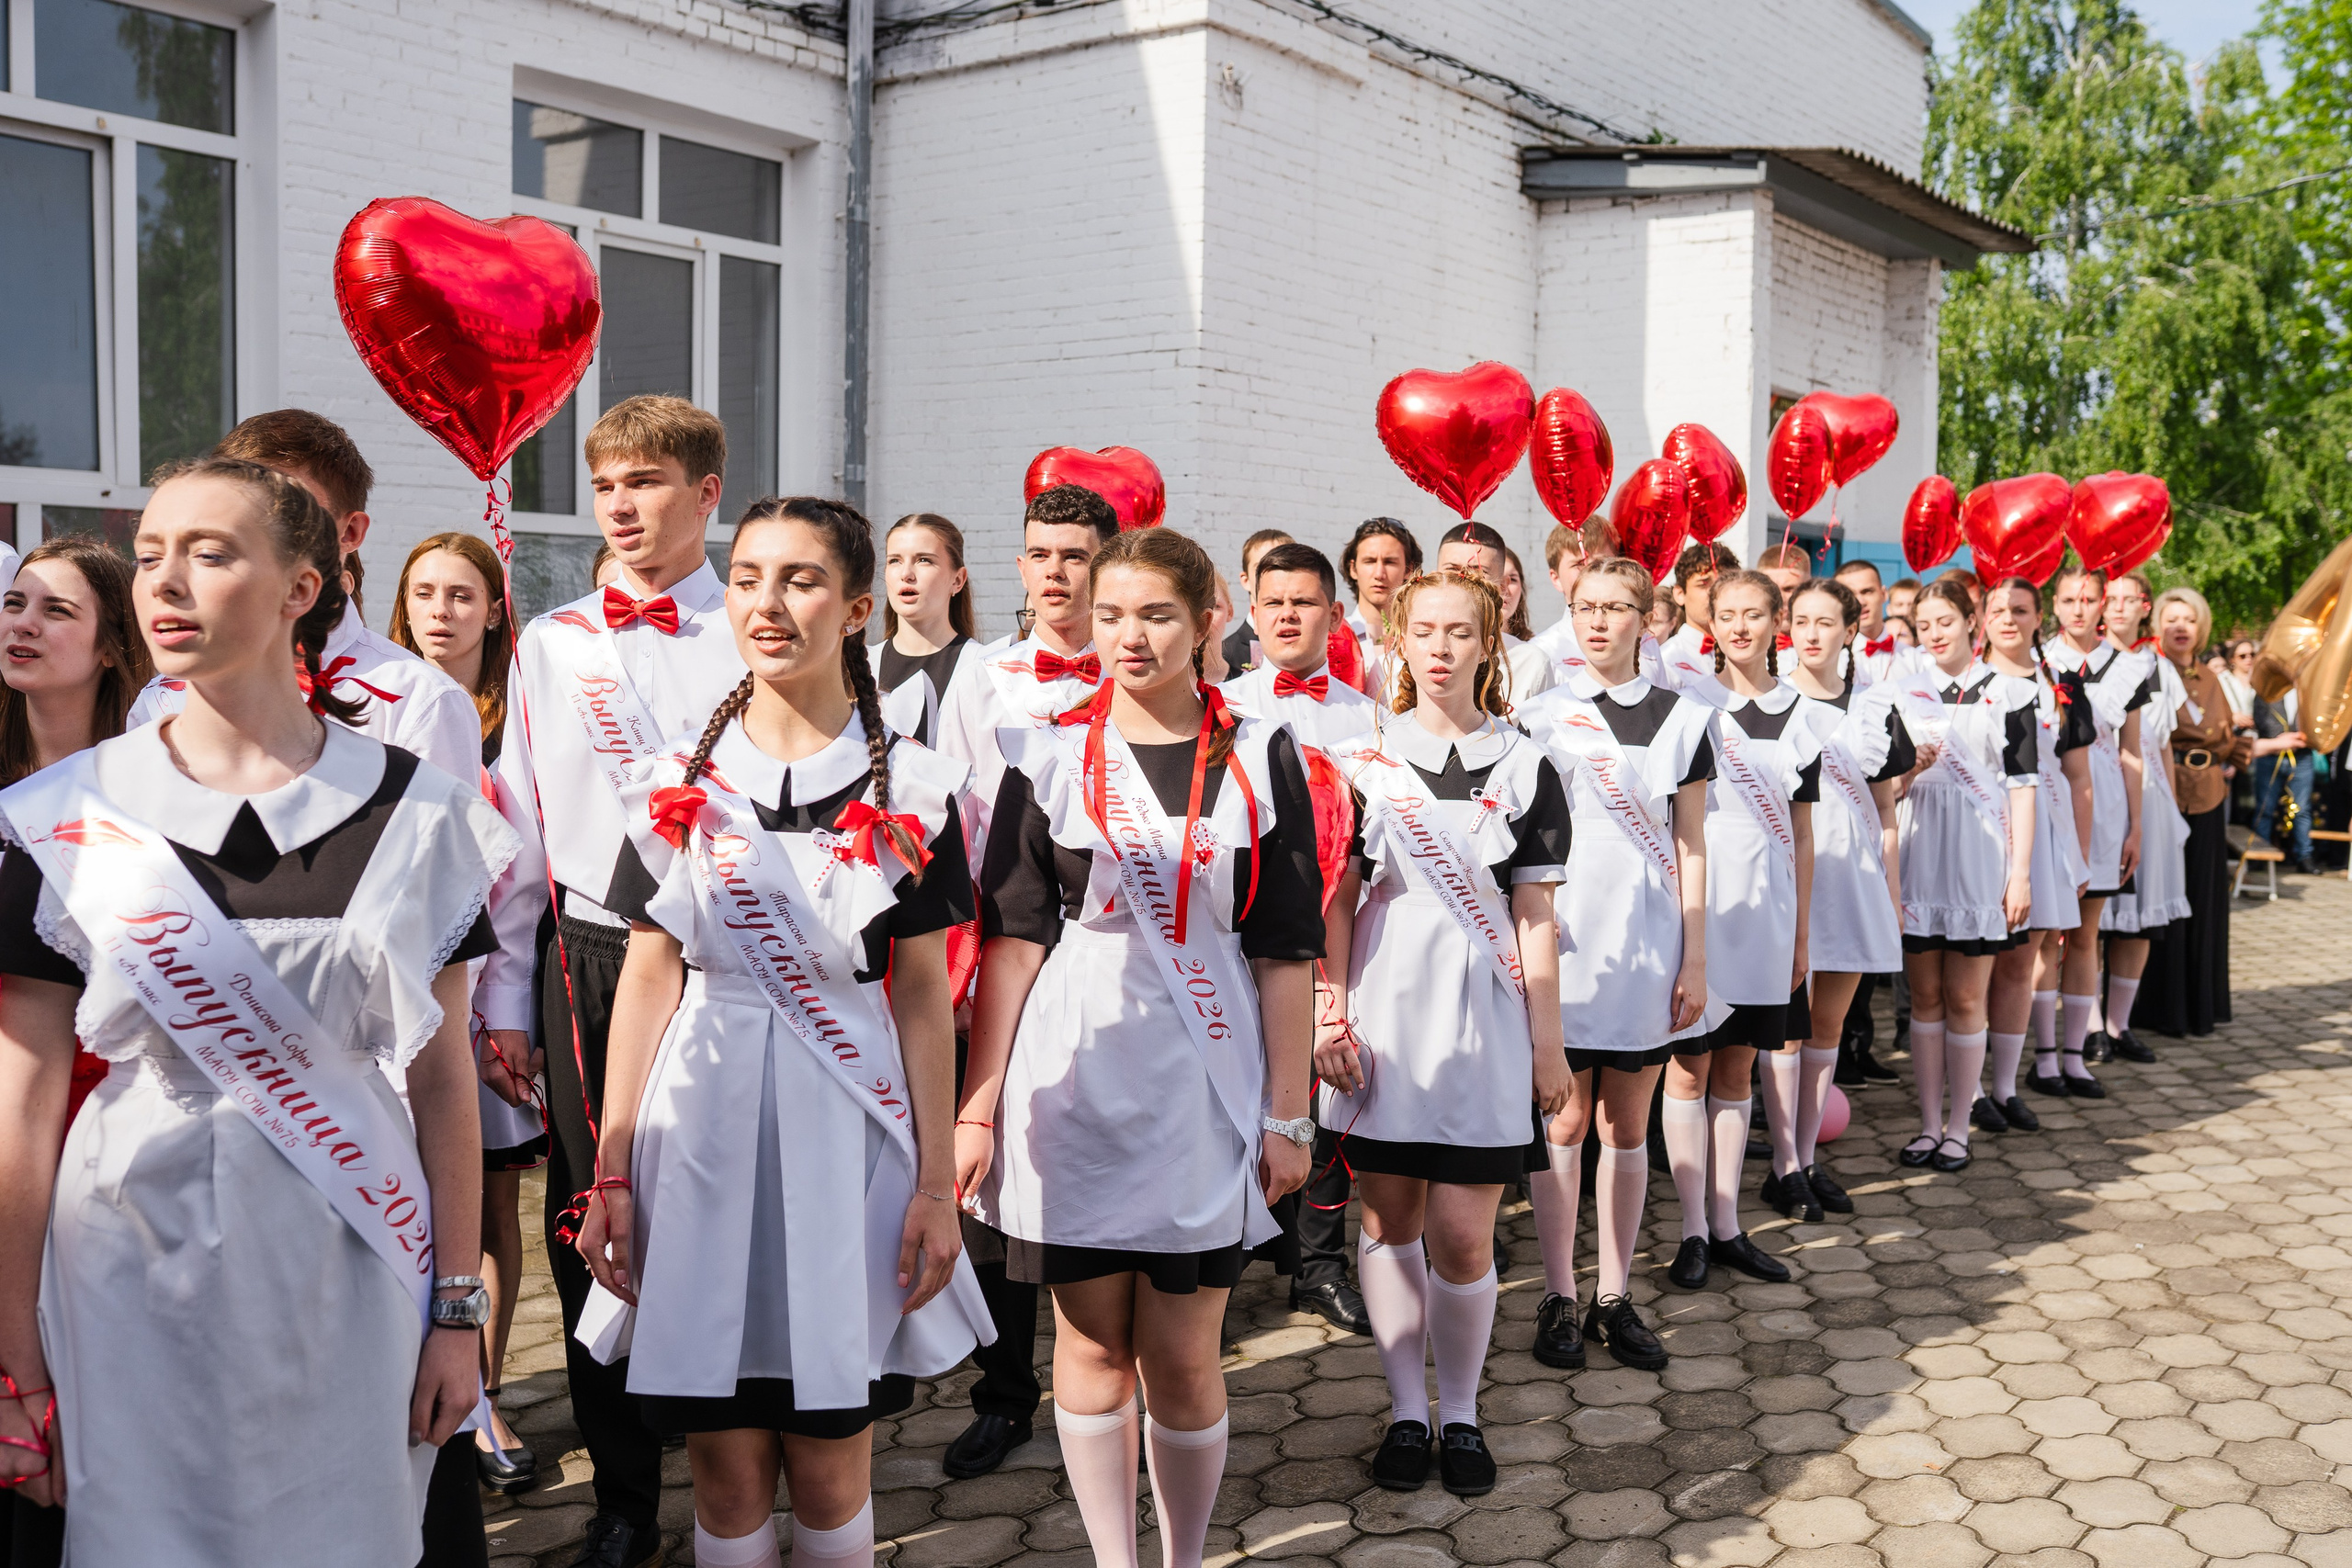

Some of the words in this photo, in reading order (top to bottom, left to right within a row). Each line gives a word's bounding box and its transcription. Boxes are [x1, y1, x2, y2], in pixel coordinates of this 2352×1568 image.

[571, 694, 582, 704] 11
[582, 721, 595, 739] класс
[572, 660, 636, 781] Выпус
[1068, 767, 1080, 775] 11
[1580, 765, 1589, 774] 11
[1723, 738, 1792, 848] Выпускница
[1132, 796, 1151, 825] Редько
[1148, 828, 1168, 861] Мария
[1380, 807, 1390, 816] 11
[1395, 829, 1408, 845] класс
[1583, 749, 1678, 879] Выпускница
[1615, 818, 1634, 839] МАОУ
[1631, 837, 1646, 852] СОШ
[1644, 852, 1659, 866] №75
[1650, 824, 1663, 842] Олеся
[706, 884, 722, 907] класс
[1120, 863, 1135, 888] СОШ
[1128, 889, 1148, 915] №75
[1383, 777, 1500, 946] Выпускница
[1497, 950, 1529, 1010] 202
[1439, 830, 1464, 866] Скляренко
[1463, 865, 1478, 893] Ксения
[699, 795, 863, 1068] Выпускница
[1421, 866, 1444, 890] МАОУ
[1440, 891, 1457, 909] СОШ
[1453, 909, 1472, 929] №75
[769, 890, 808, 946] Тарасова
[804, 948, 831, 982] Алиса
[104, 937, 123, 953] 11
[134, 979, 163, 1007] класс
[741, 943, 771, 979] МАОУ
[765, 981, 791, 1009] СОШ
[785, 1010, 811, 1039] №75
[1170, 956, 1233, 1041] 2026
[228, 973, 282, 1033] Денисова
[280, 1033, 314, 1070] Софья
[115, 866, 369, 1172] Выпускница
[356, 1173, 434, 1275] 2026
[195, 1045, 241, 1086] МАОУ
[234, 1085, 270, 1119] СОШ
[264, 1117, 301, 1149] №75
